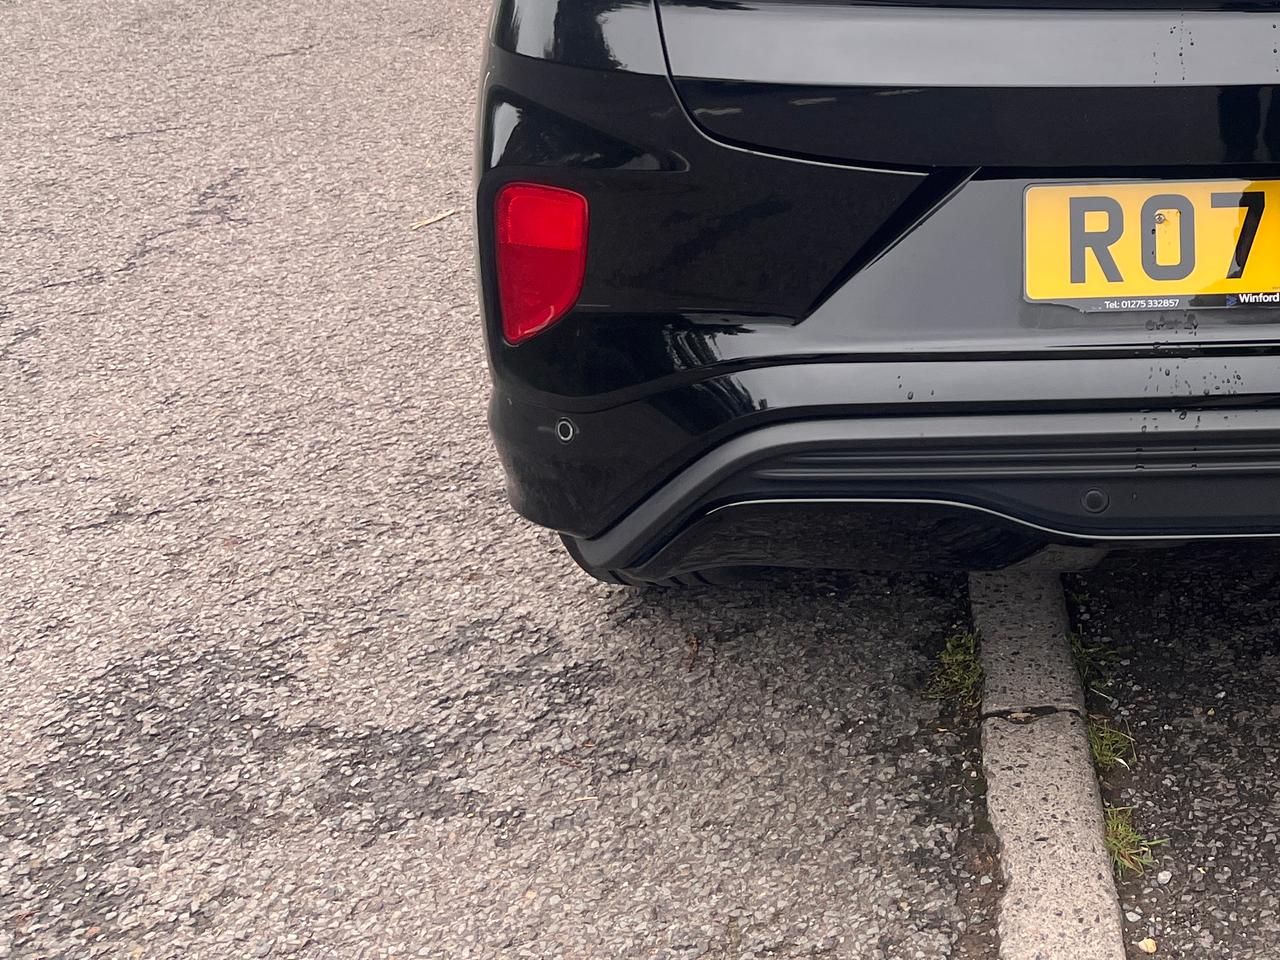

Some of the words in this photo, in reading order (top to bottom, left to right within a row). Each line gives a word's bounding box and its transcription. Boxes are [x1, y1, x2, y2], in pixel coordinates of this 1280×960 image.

[1239, 292, 1280, 303] Winford
[1104, 301, 1120, 309] Tel:
[1121, 300, 1146, 308] 01275
[1147, 299, 1180, 308] 332857
